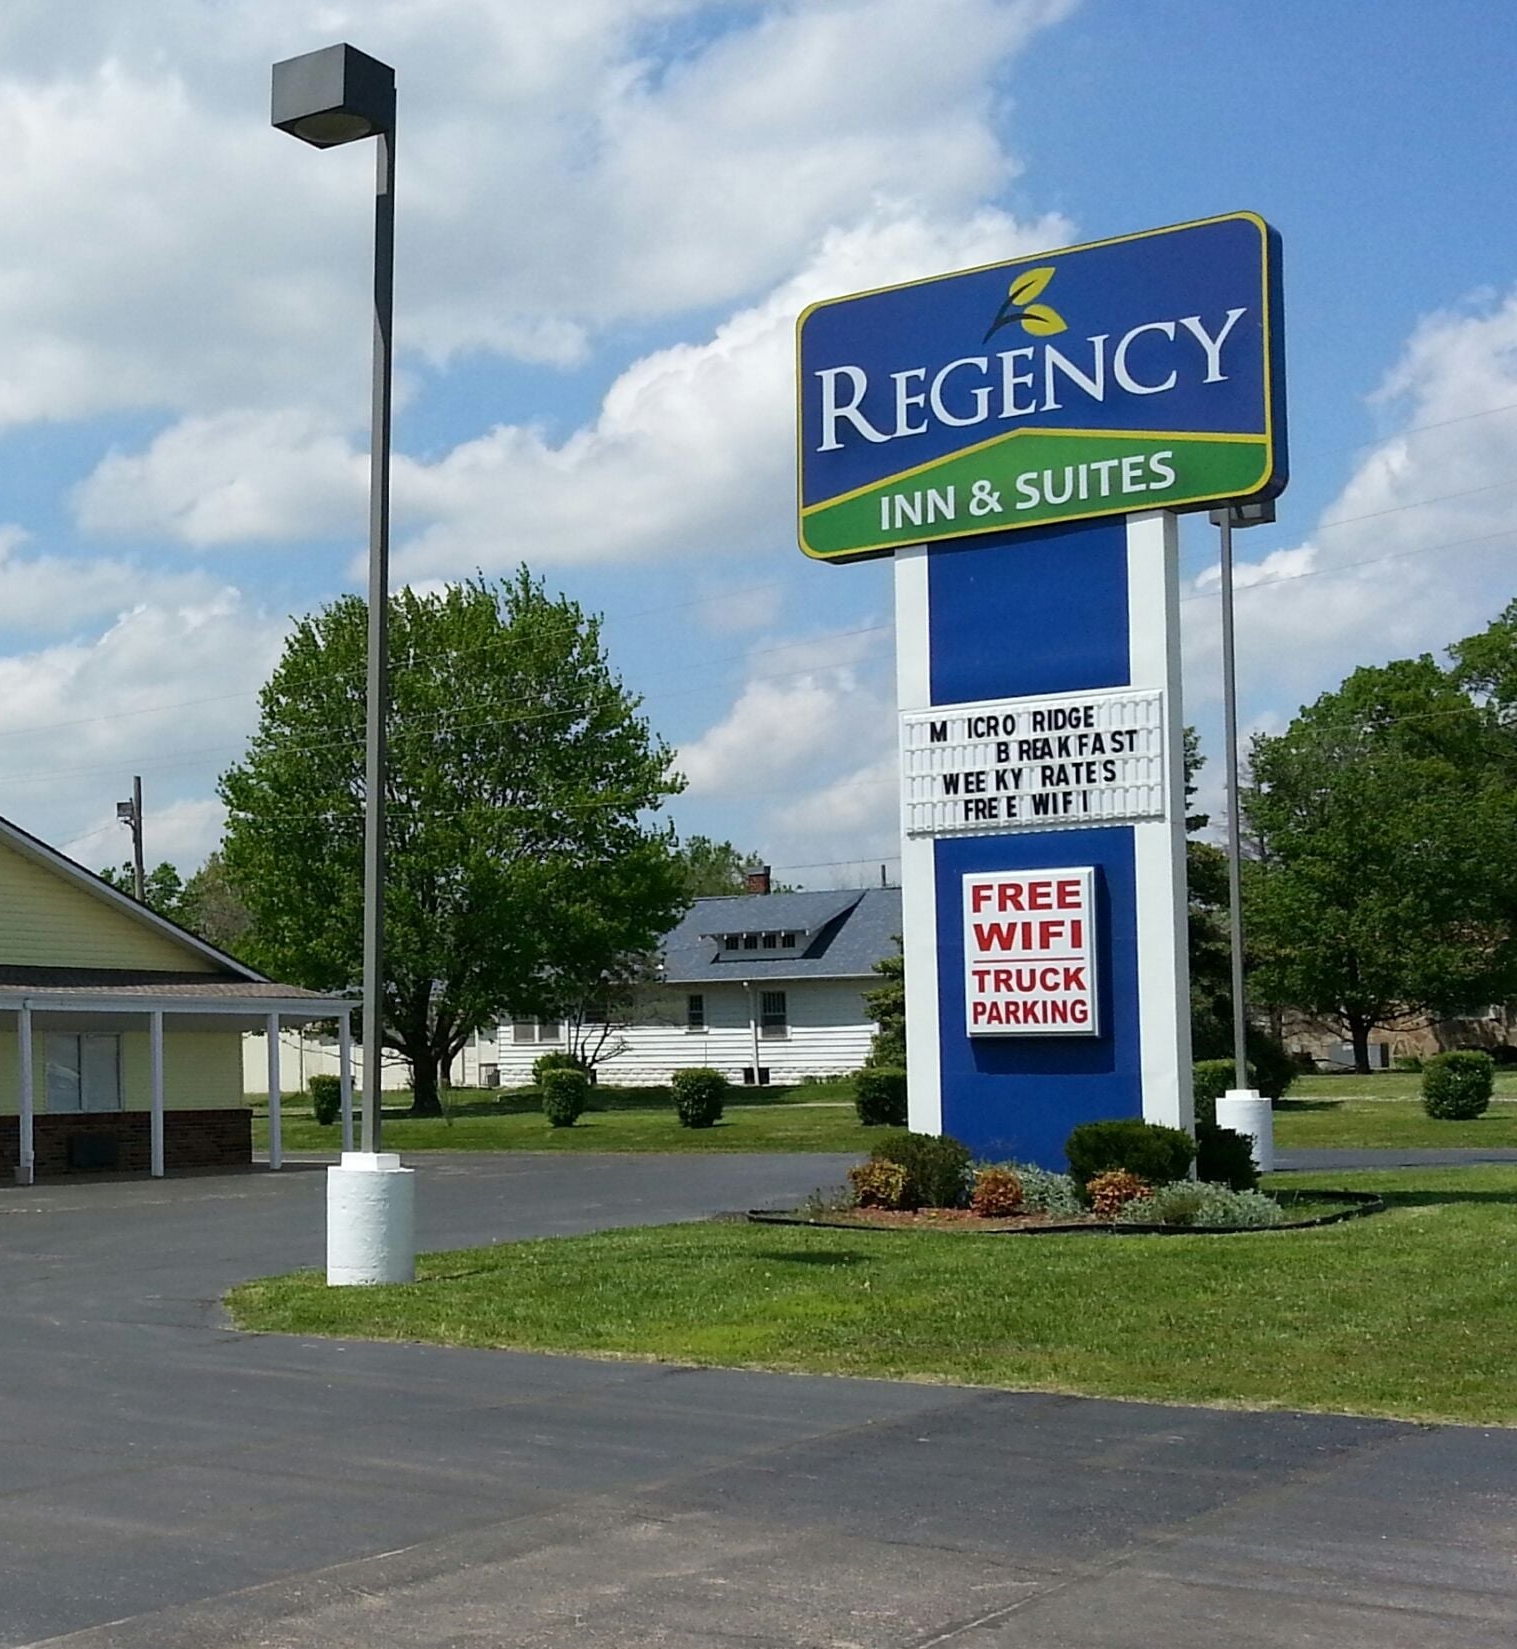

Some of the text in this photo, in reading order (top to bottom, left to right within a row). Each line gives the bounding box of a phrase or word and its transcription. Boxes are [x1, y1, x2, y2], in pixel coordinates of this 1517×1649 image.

[815, 307, 1247, 452] REGENCY
[881, 451, 1176, 530] INN & SUITES
[930, 705, 1094, 743] MICRO RIDGE
[997, 729, 1138, 763] BREAKFAST
[943, 759, 1116, 795] WEEKY RATES
[964, 790, 1088, 821] FREE WIFI
[972, 879, 1082, 913] FREE
[973, 919, 1082, 952] WIFI
[972, 966, 1086, 993] TRUCK
[972, 999, 1088, 1025] PARKING
